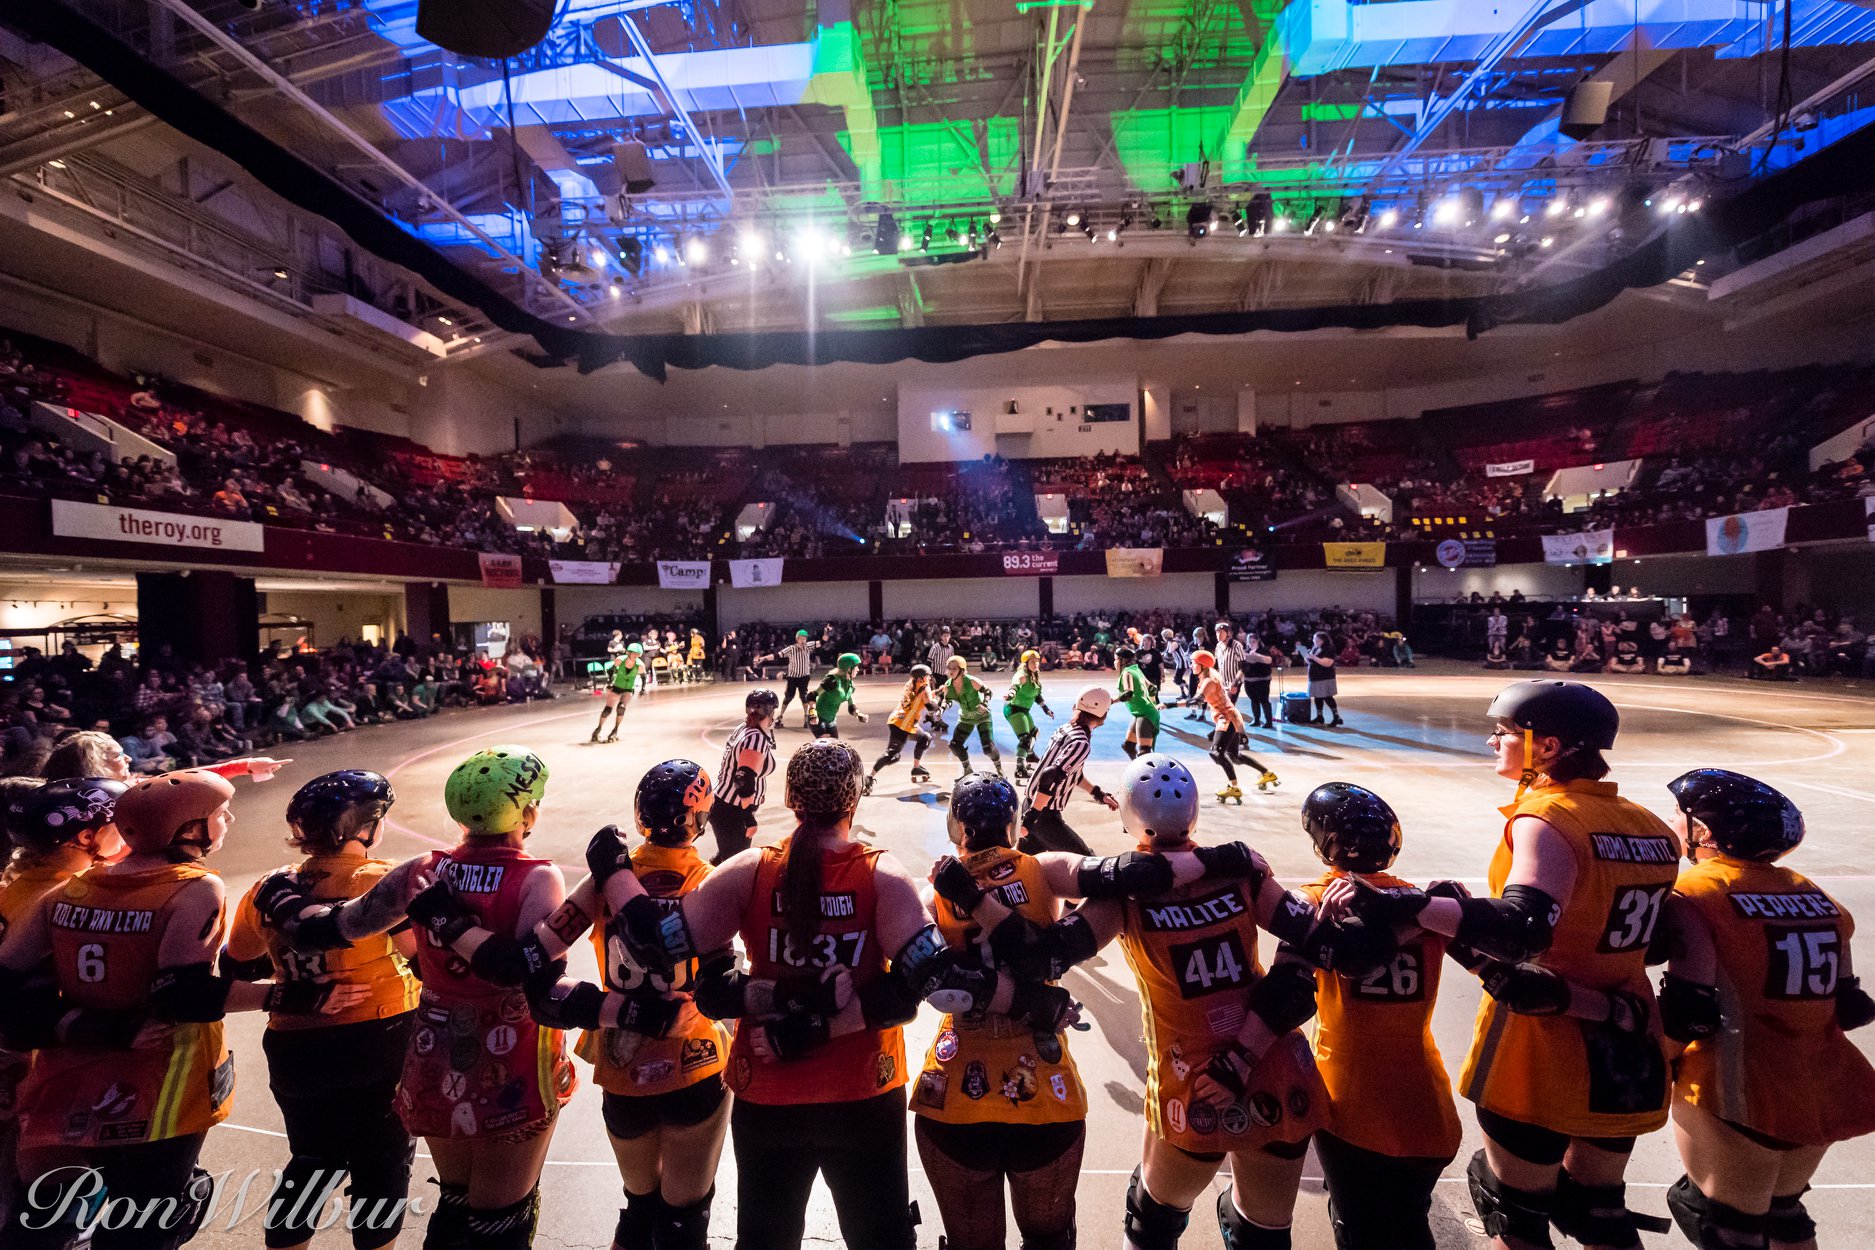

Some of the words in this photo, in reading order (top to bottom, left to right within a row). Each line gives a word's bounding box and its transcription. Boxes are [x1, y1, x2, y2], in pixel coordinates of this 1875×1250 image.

[119, 514, 222, 545] theroy.org
[670, 566, 703, 579] Camp
[1003, 554, 1030, 569] 89.3
[1032, 554, 1044, 562] the
[1032, 560, 1058, 568] current
[1591, 834, 1631, 860] HOMO
[88, 909, 115, 931] ANN
[114, 911, 153, 932] LENA
[1146, 893, 1244, 929] MALICE
[1609, 887, 1666, 948] 31
[1731, 893, 1839, 918] PEPPERS
[77, 943, 105, 982] 6
[1185, 941, 1243, 988] 44
[1361, 952, 1418, 995] 26
[1775, 931, 1838, 995] 15
